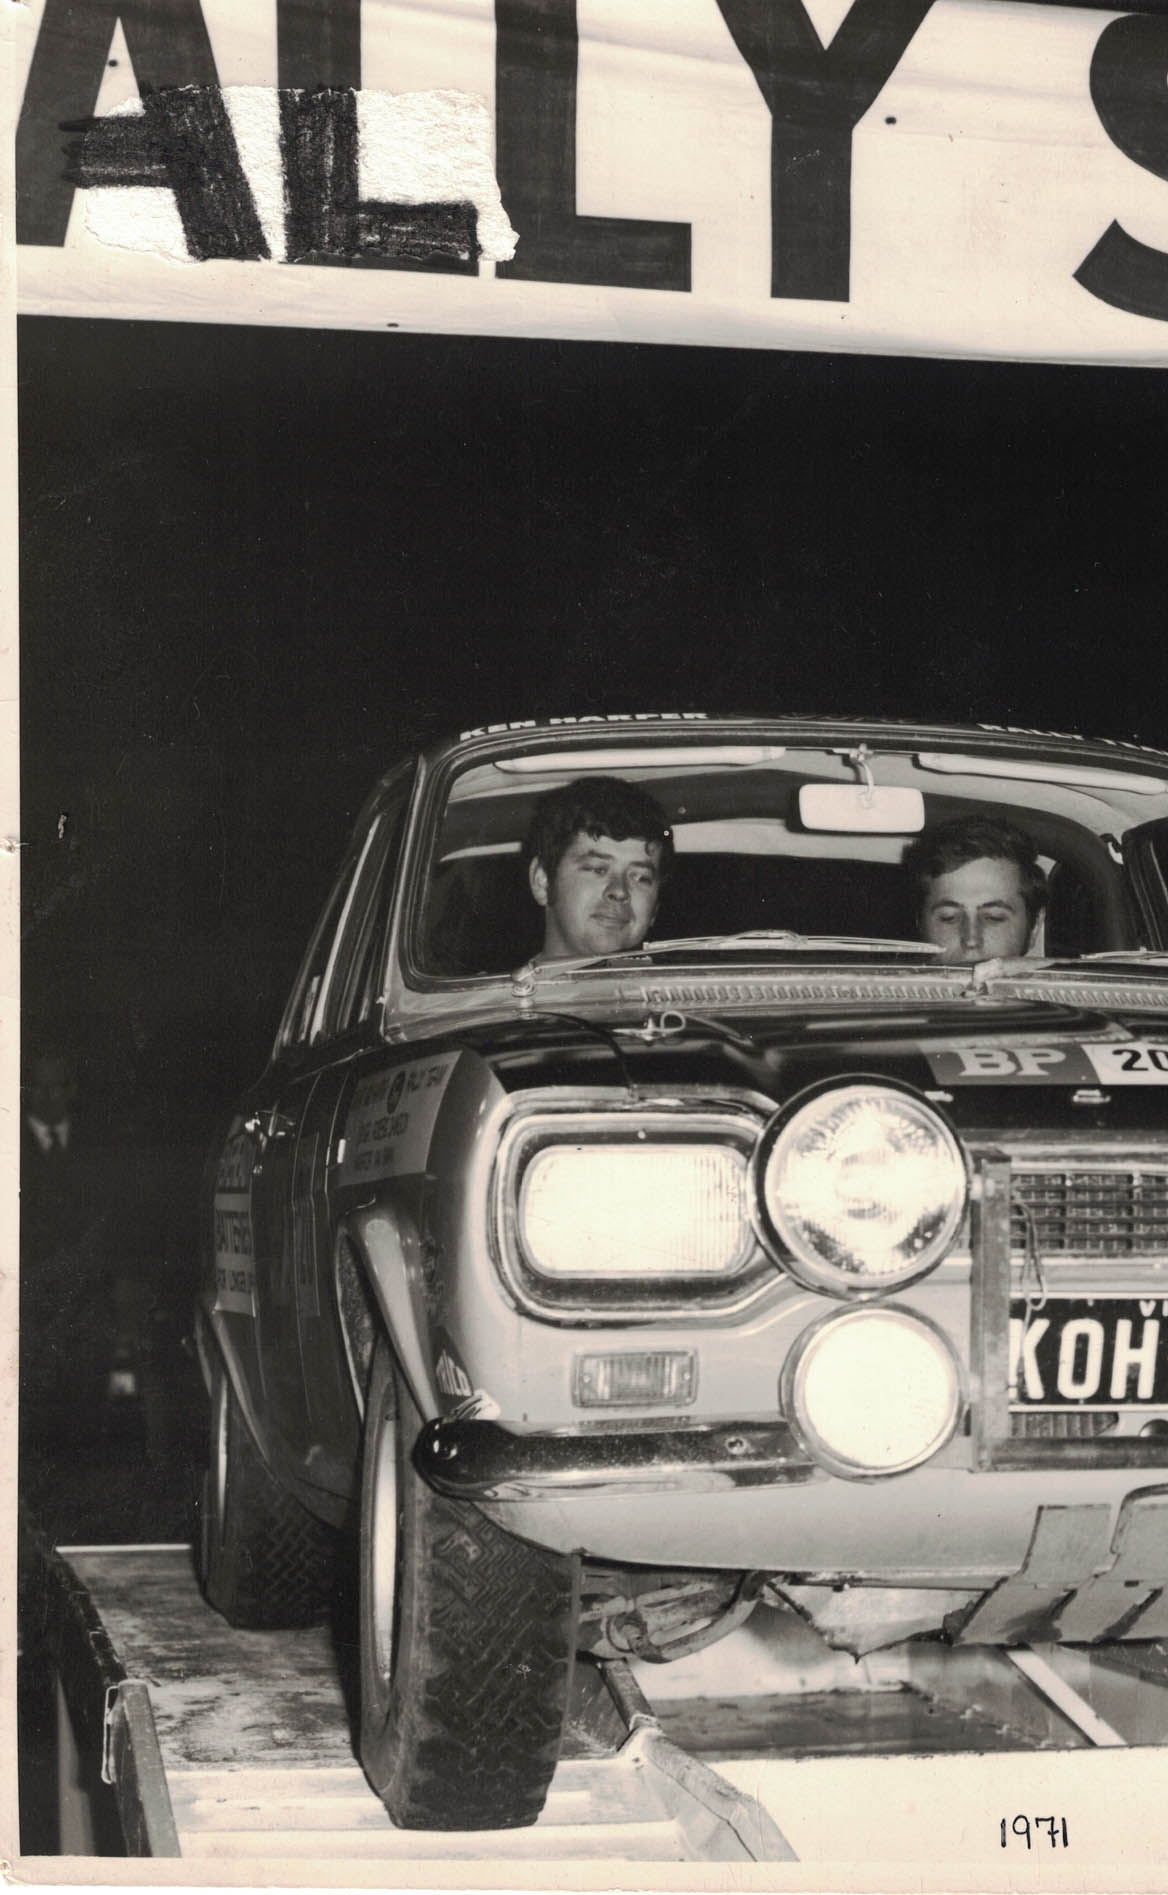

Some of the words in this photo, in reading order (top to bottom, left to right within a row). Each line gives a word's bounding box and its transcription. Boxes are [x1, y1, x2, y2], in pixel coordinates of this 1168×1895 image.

[459, 720, 537, 741] KEN
[549, 712, 709, 725] HARPER
[957, 1047, 1068, 1077] BP
[1000, 1814, 1069, 1849] 1971
